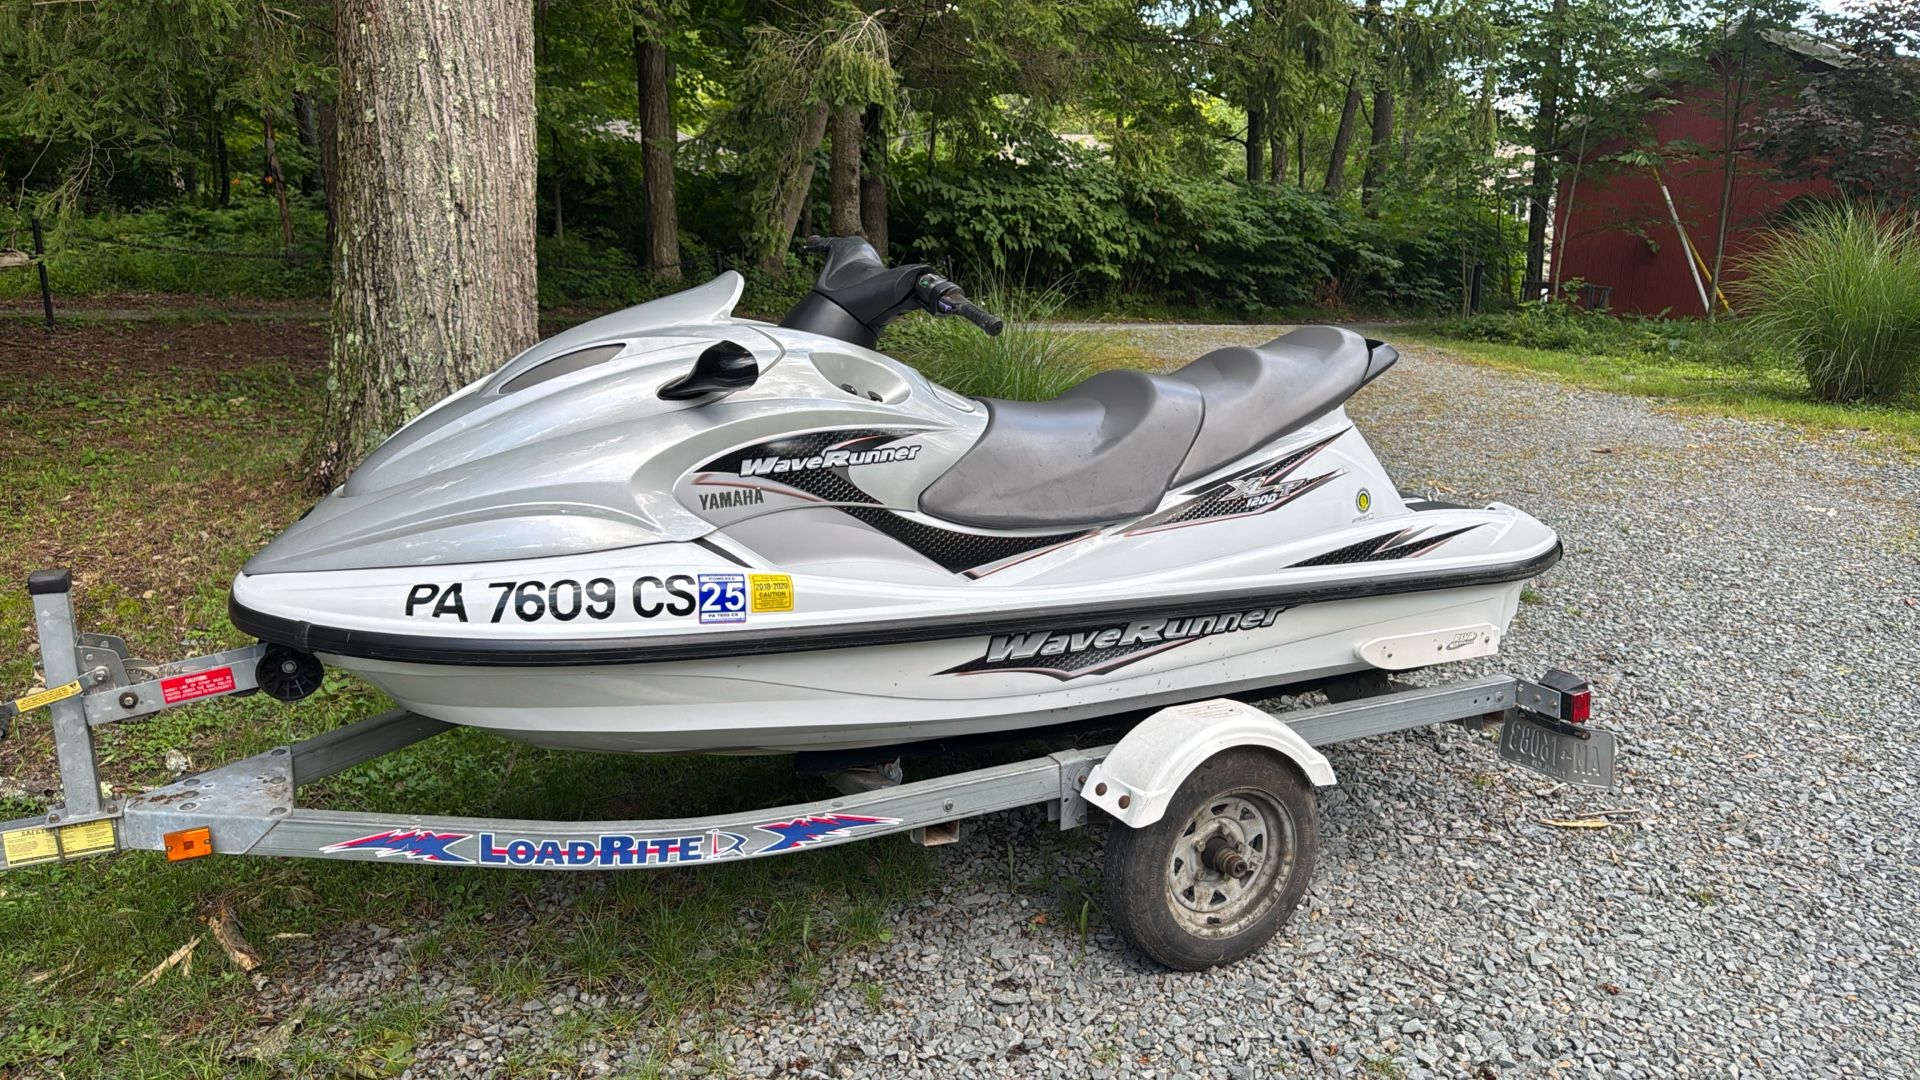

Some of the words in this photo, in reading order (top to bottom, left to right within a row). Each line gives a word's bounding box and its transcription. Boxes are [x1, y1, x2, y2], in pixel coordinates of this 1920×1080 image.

[739, 445, 921, 477] WaveRunner
[699, 488, 764, 511] YAMAHA
[1246, 493, 1277, 507] 1200
[405, 583, 468, 622] PA
[488, 577, 613, 623] 7609
[632, 574, 697, 618] CS
[701, 582, 745, 611] 25
[986, 607, 1286, 663] WaveRunner
